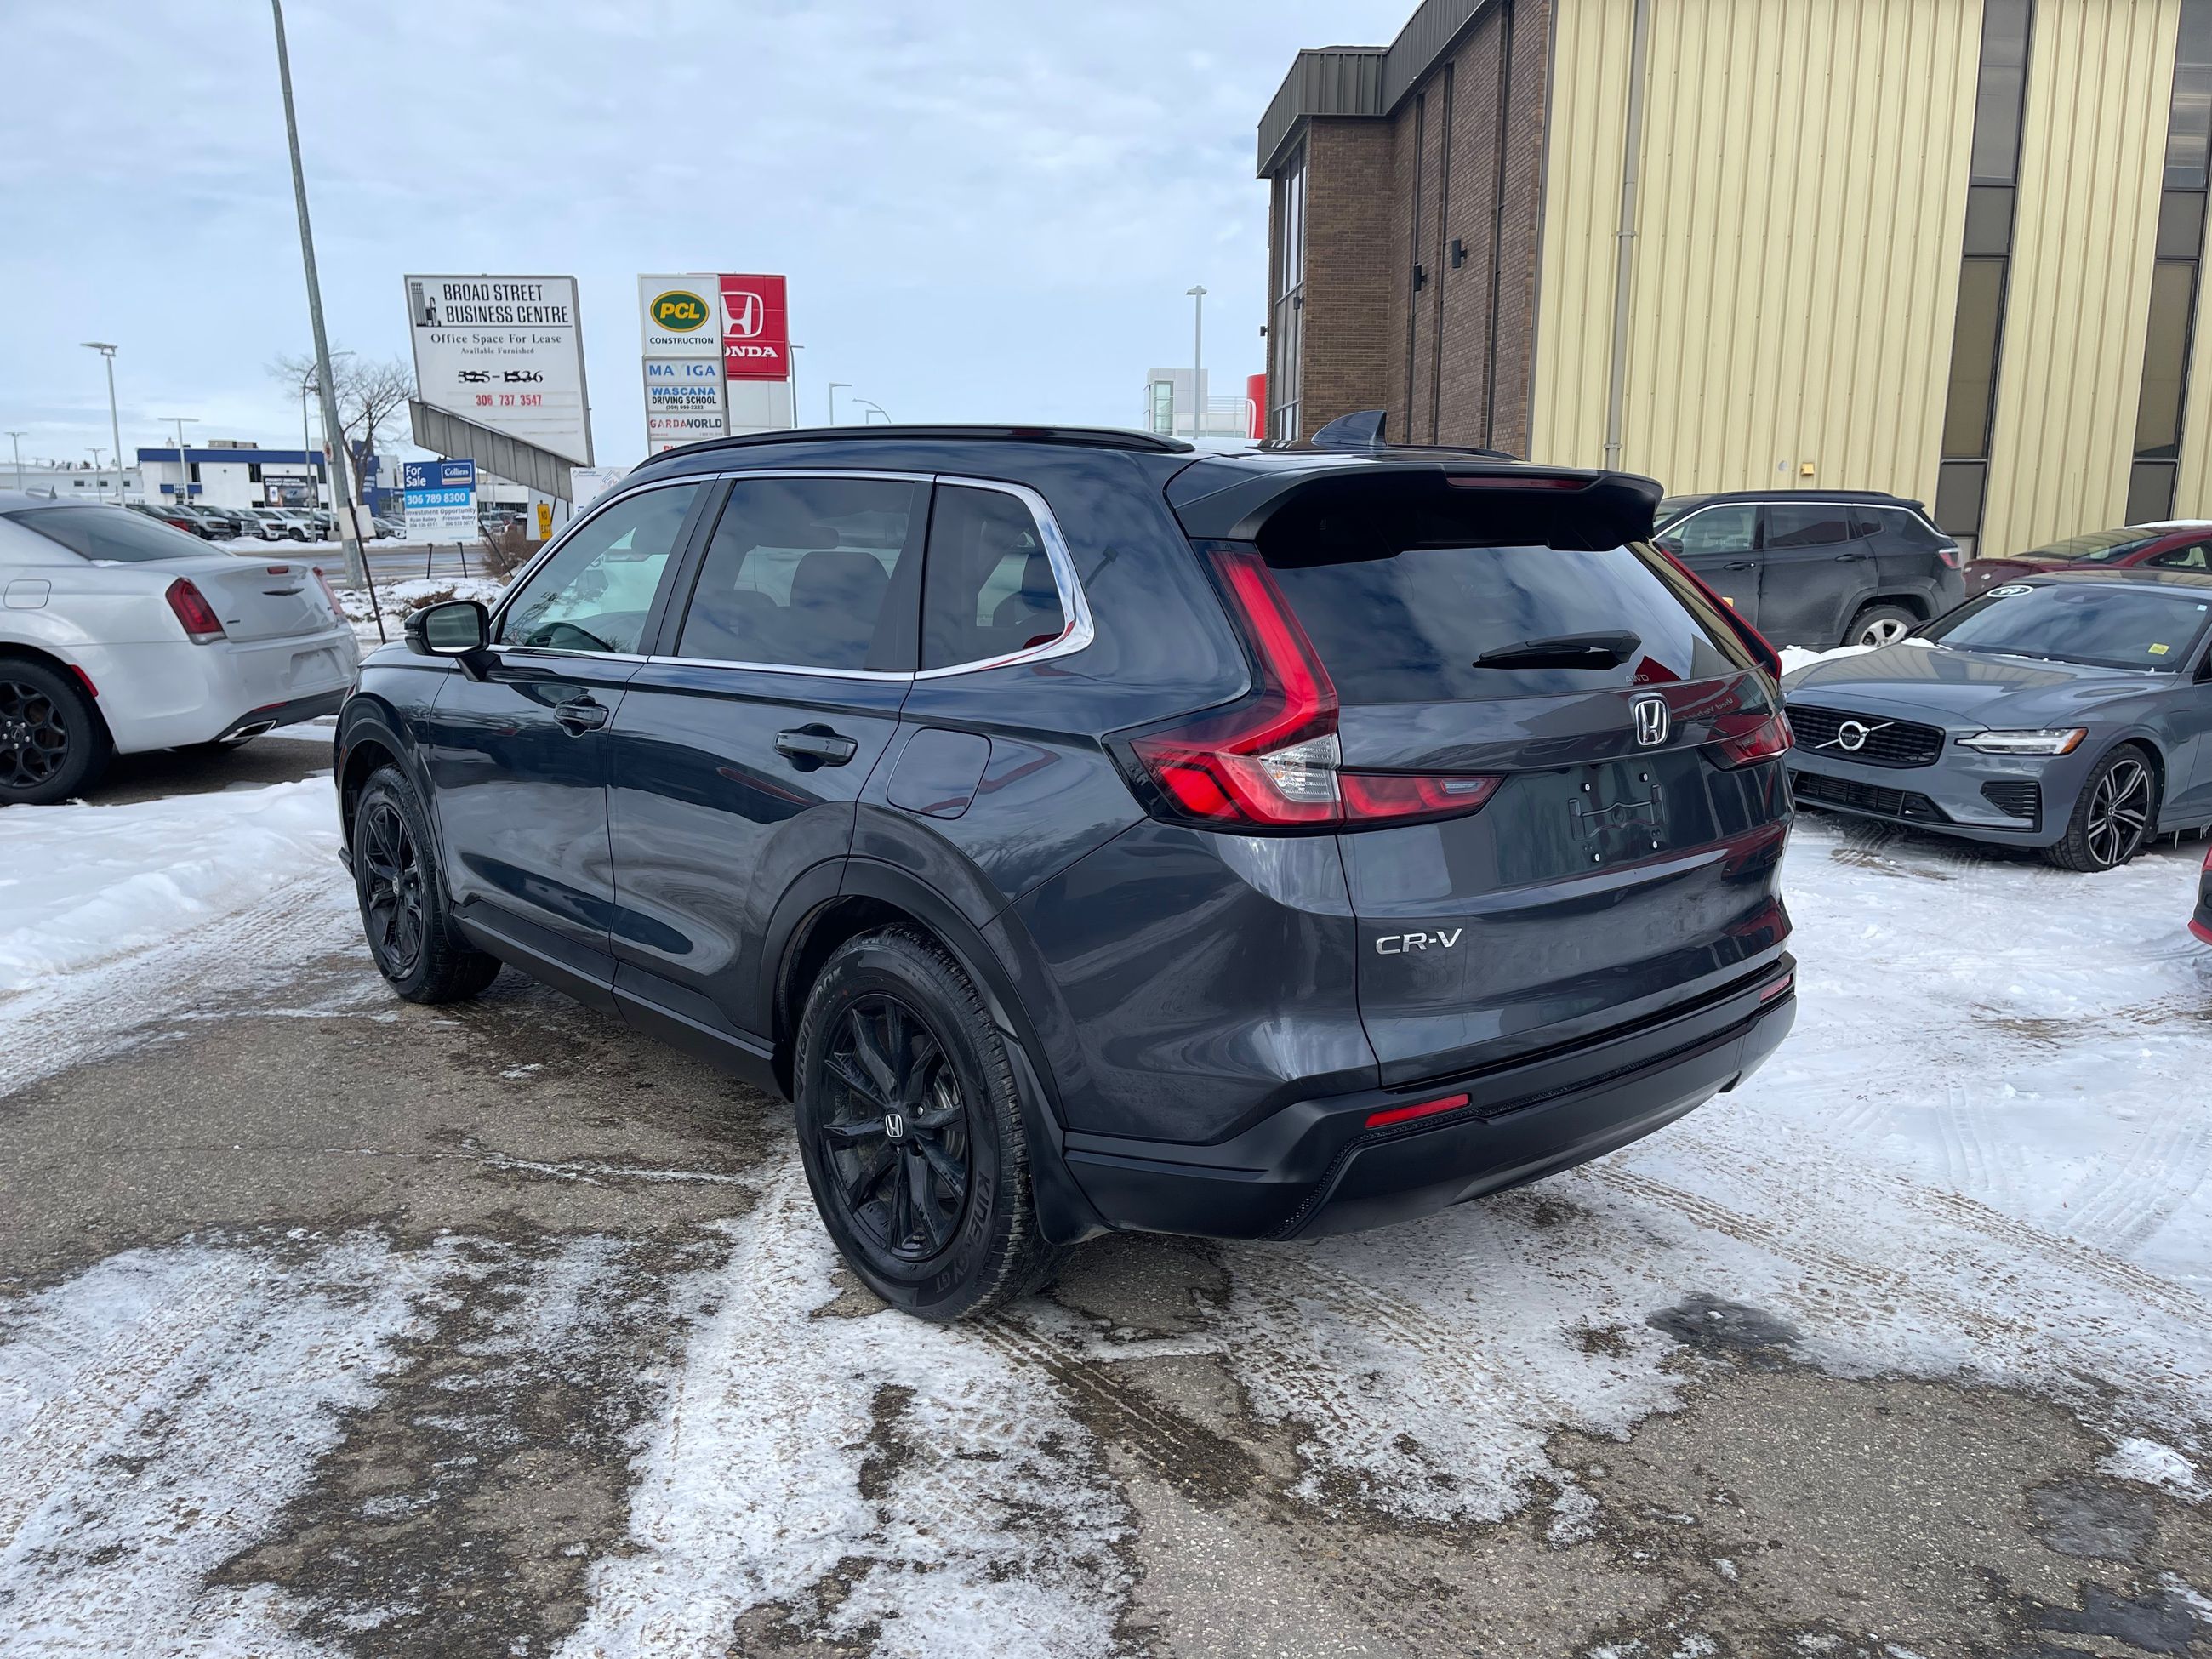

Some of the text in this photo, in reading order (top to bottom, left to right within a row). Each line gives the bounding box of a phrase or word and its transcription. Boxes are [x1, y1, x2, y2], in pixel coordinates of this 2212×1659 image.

[443, 283, 543, 302] BROAD STREET
[446, 305, 569, 323] BUSINESS CENTRE
[659, 302, 700, 320] PCL
[430, 333, 562, 345] Office Space For Lease
[725, 345, 779, 358] NDA
[652, 387, 716, 396] WASCANA
[476, 394, 542, 407] 306 737 3547
[652, 396, 716, 405] DRIVING SCHOOL
[405, 465, 422, 476] For
[444, 467, 469, 476] Colliers
[405, 476, 427, 487] Sale
[407, 492, 466, 505] 306 789 8300
[439, 507, 476, 516] Opportunity
[541, 510, 548, 520] NO
[540, 523, 551, 534] EXIT
[1625, 673, 1650, 683] AWD
[1375, 927, 1462, 955] CR-V
